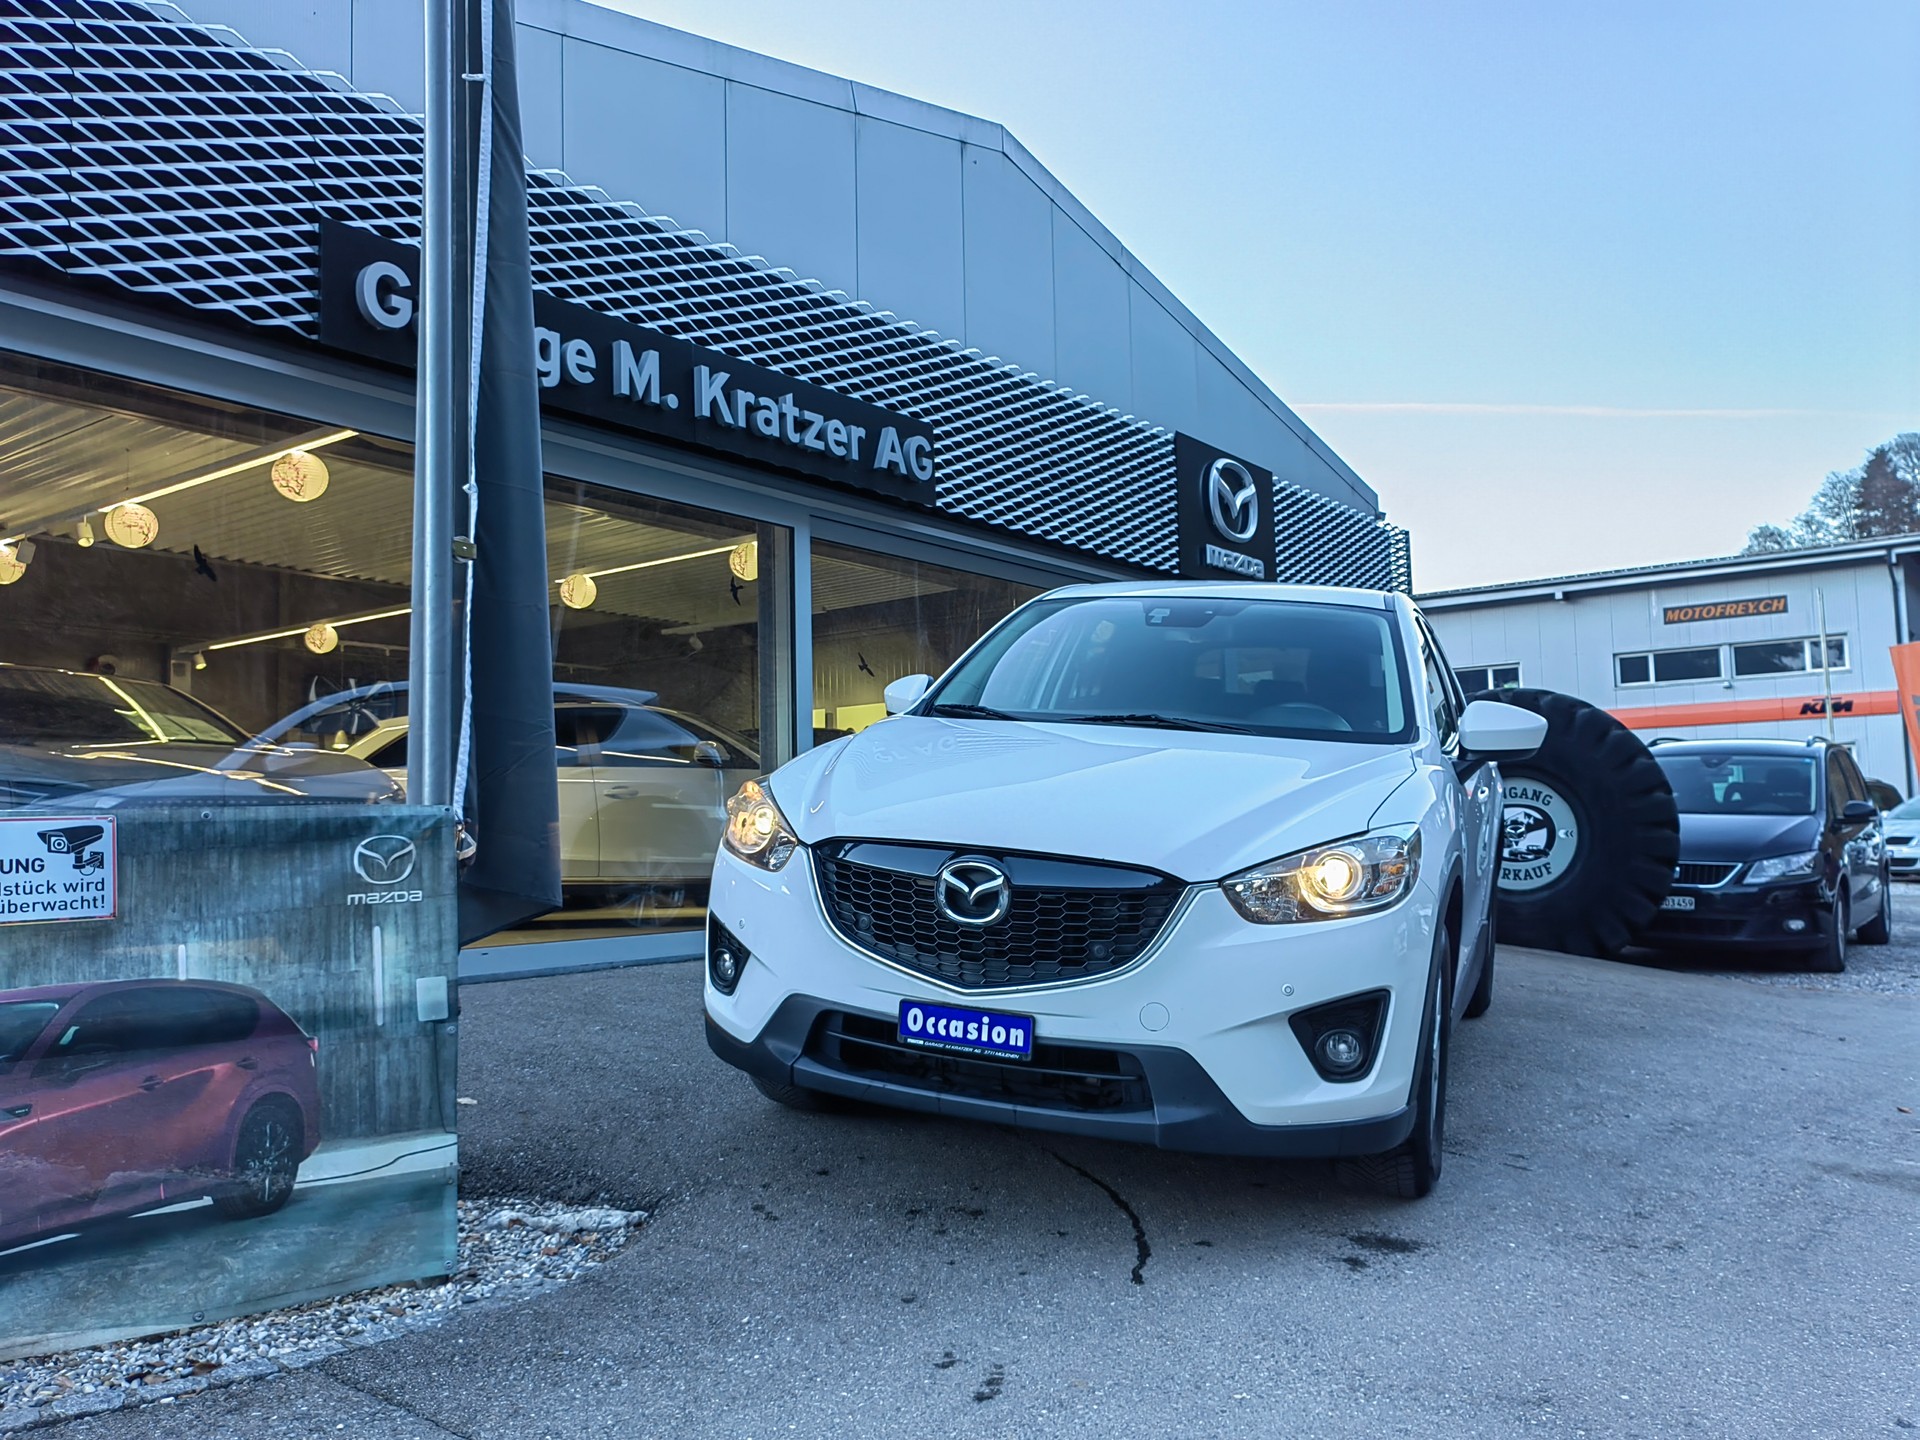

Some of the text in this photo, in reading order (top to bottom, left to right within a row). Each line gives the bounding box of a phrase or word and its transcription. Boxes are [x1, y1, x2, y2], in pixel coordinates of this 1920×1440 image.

[356, 261, 933, 481] Gge M. Kratzer AG
[1666, 598, 1785, 622] MOTOFREY.CH
[1800, 697, 1853, 715] KTM
[1502, 787, 1553, 806] GANG
[0, 857, 45, 874] UNG
[0, 877, 105, 896] stück wird
[907, 1007, 1025, 1047] Occasion
